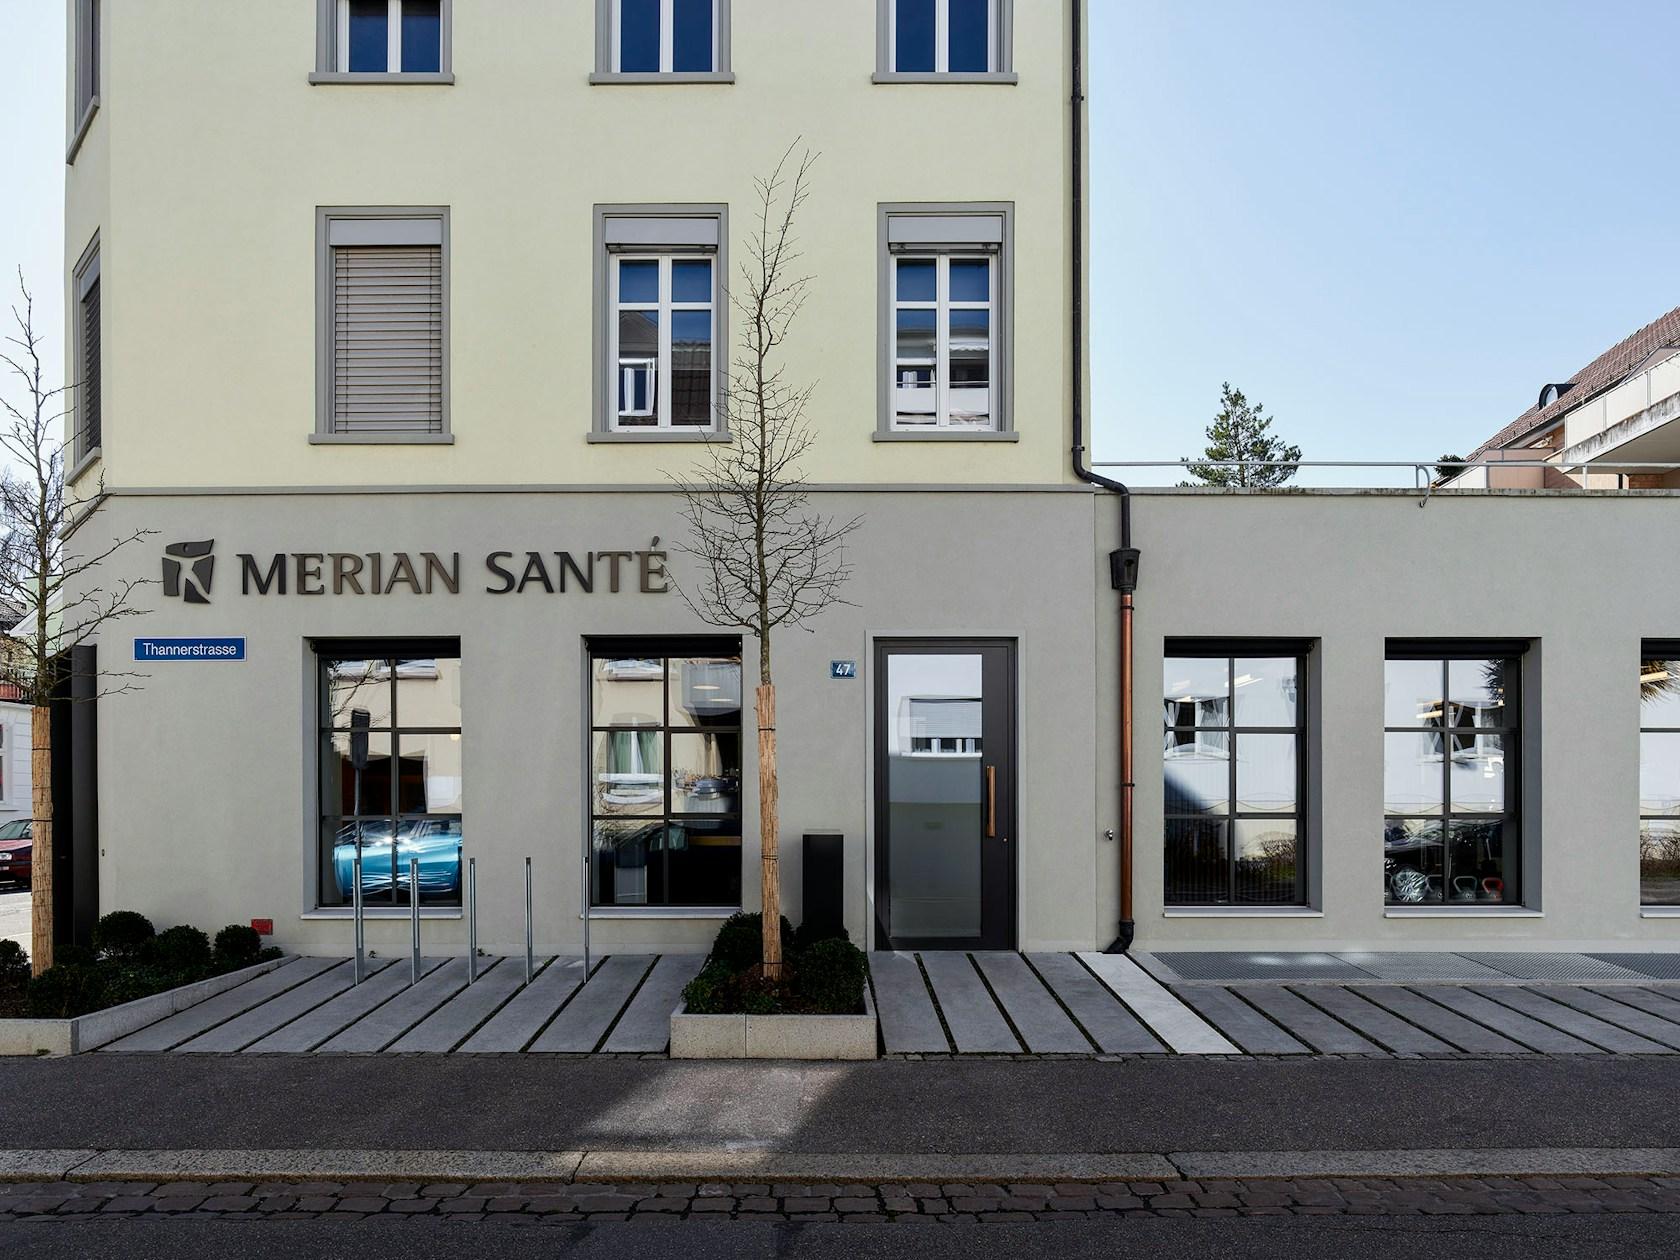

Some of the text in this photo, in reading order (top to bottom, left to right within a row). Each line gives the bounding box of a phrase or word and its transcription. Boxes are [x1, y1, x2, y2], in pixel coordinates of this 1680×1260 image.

[236, 535, 668, 595] MERIAN SANTÉ
[143, 643, 237, 656] Thannerstrasse
[836, 663, 851, 676] 47
